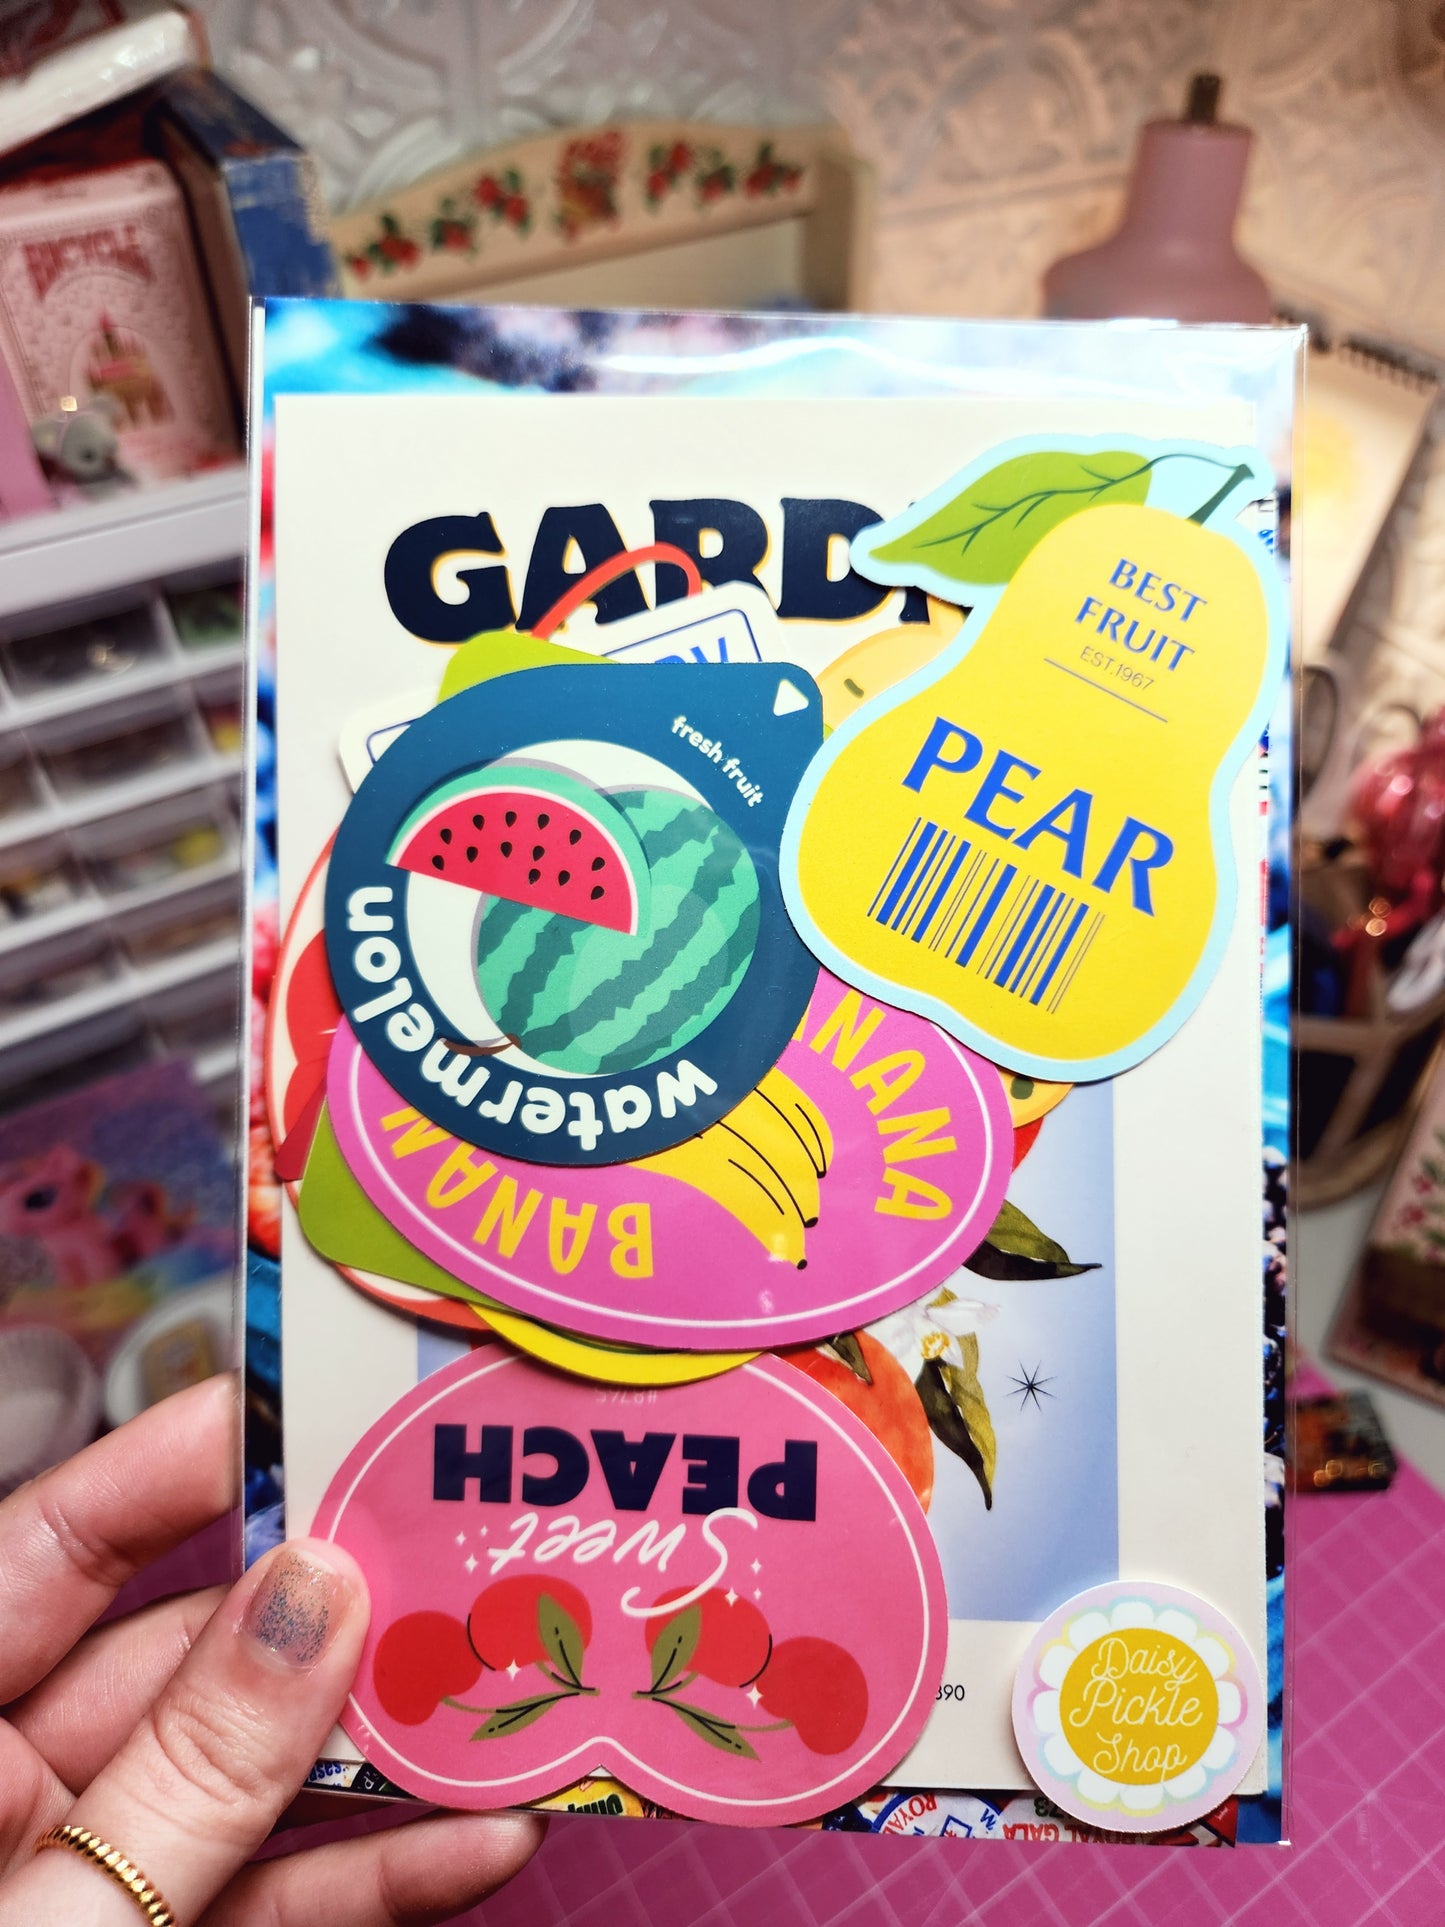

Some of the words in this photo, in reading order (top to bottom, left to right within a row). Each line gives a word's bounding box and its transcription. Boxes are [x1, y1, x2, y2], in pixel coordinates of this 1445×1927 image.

[1074, 596, 1195, 671] FRUIT
[1108, 558, 1208, 623] BEST
[1080, 646, 1154, 691] EST.1967
[671, 715, 723, 764] fresh
[722, 758, 763, 807] fruit
[901, 716, 1174, 917] PEAR
[346, 886, 719, 1151] watermelon
[792, 989, 957, 1221] NANA
[380, 1106, 654, 1280] BANAN
[433, 1423, 818, 1522] PEACH
[487, 1507, 758, 1618] Sweet
[1069, 1676, 1203, 1727] Pickle
[1091, 1637, 1198, 1691] Daisy
[1093, 1733, 1187, 1783] Shop
